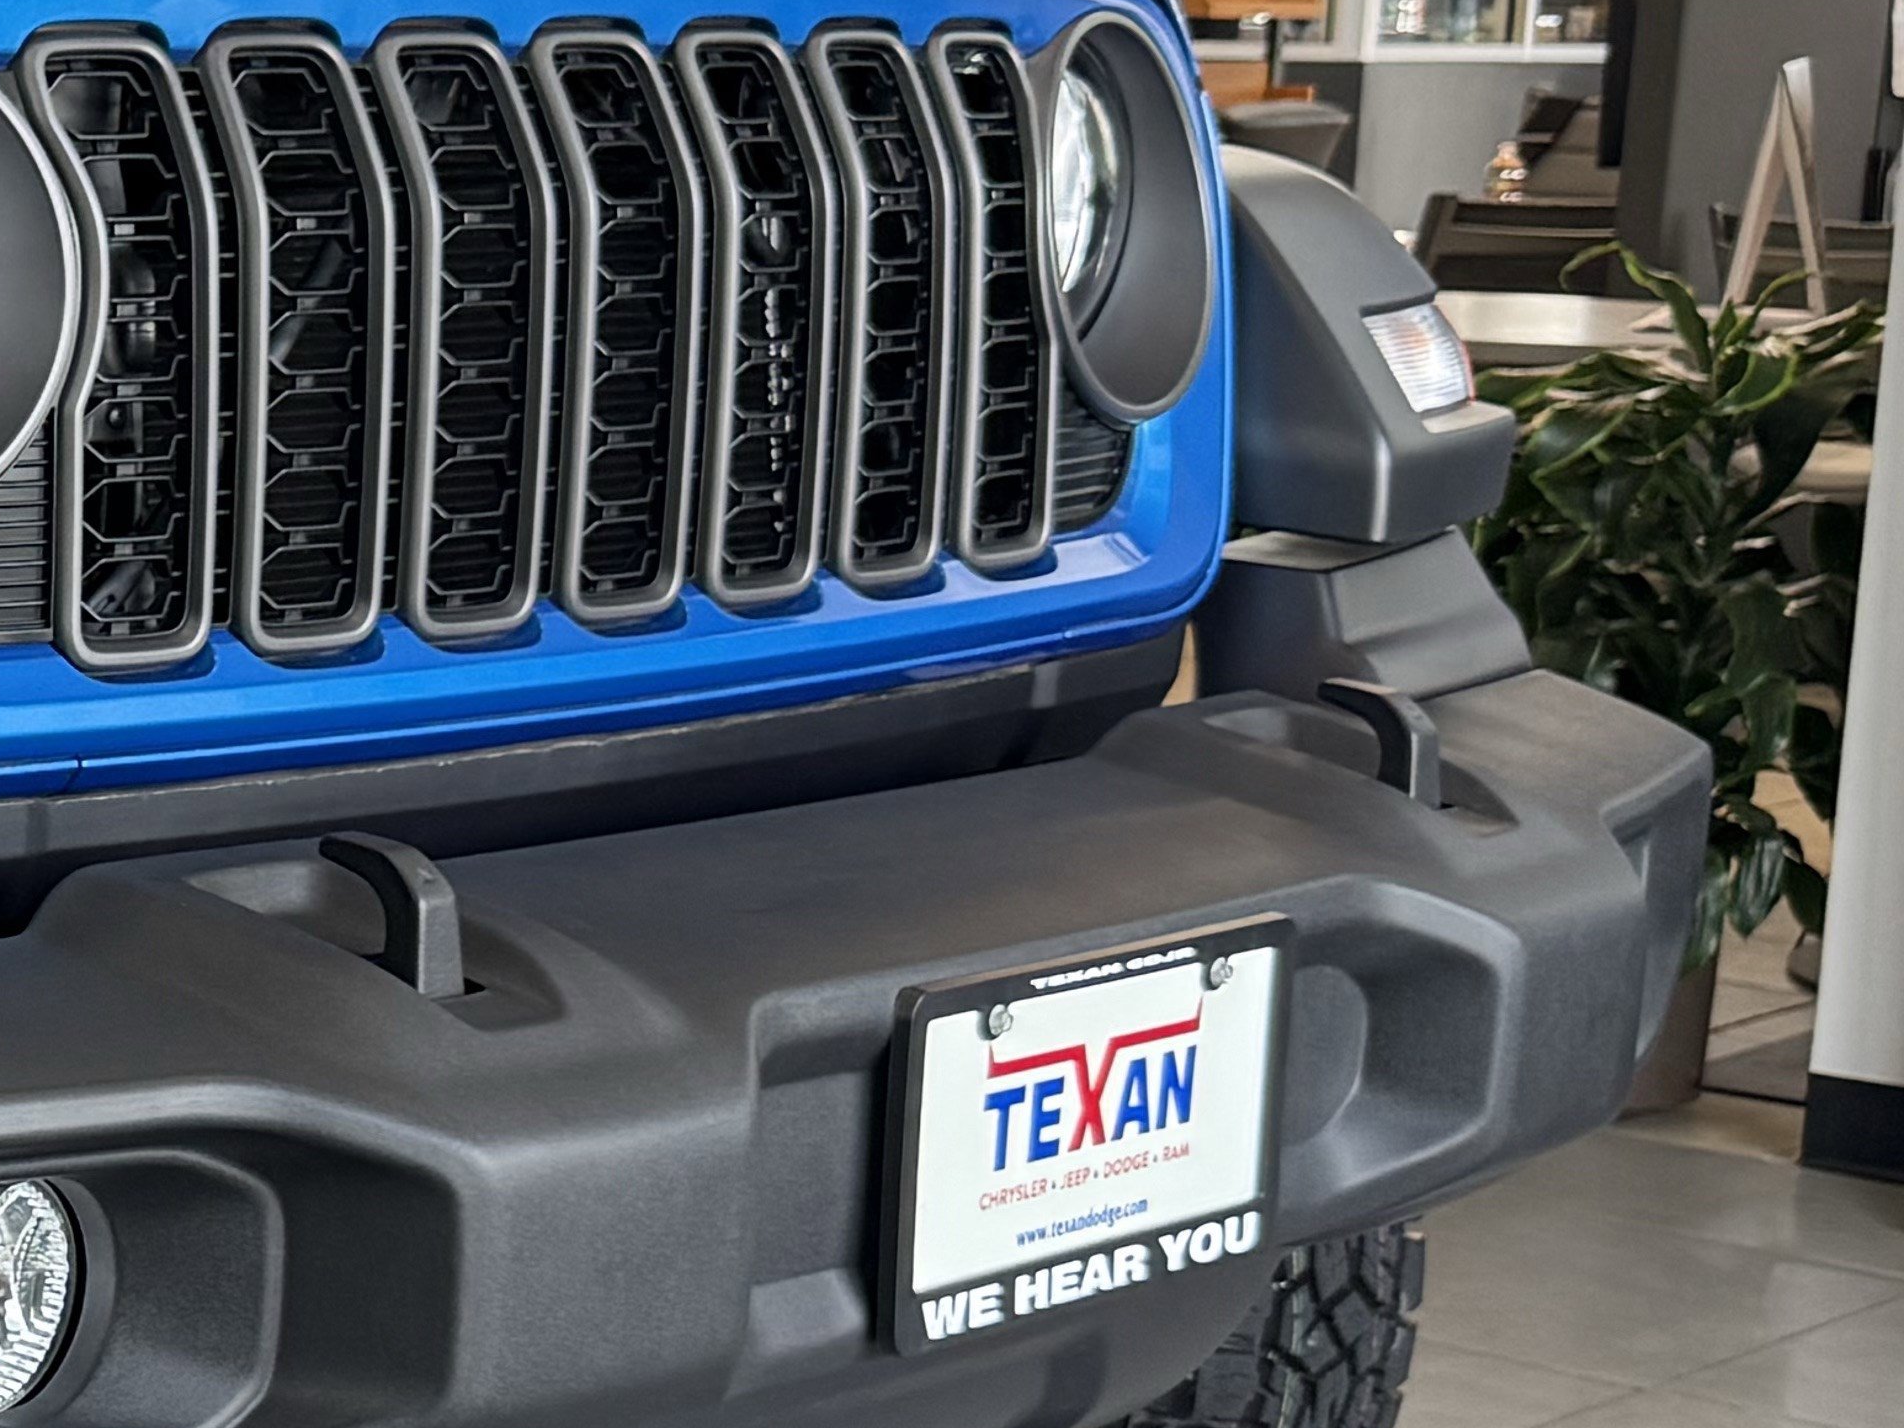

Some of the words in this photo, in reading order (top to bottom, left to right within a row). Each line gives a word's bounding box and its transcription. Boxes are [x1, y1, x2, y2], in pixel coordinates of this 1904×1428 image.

[1029, 962, 1126, 990] TEXAN
[983, 1002, 1201, 1172] TEXAN
[978, 1178, 1048, 1210] CHRYSLER
[1058, 1167, 1091, 1190] JEEP
[1103, 1150, 1149, 1179] DODGE
[1162, 1142, 1190, 1162] RAM
[1015, 1197, 1148, 1247] www.texandodge.com
[921, 1282, 1006, 1341] WE
[1014, 1243, 1150, 1316] HEAR
[1158, 1210, 1261, 1272] YOU
